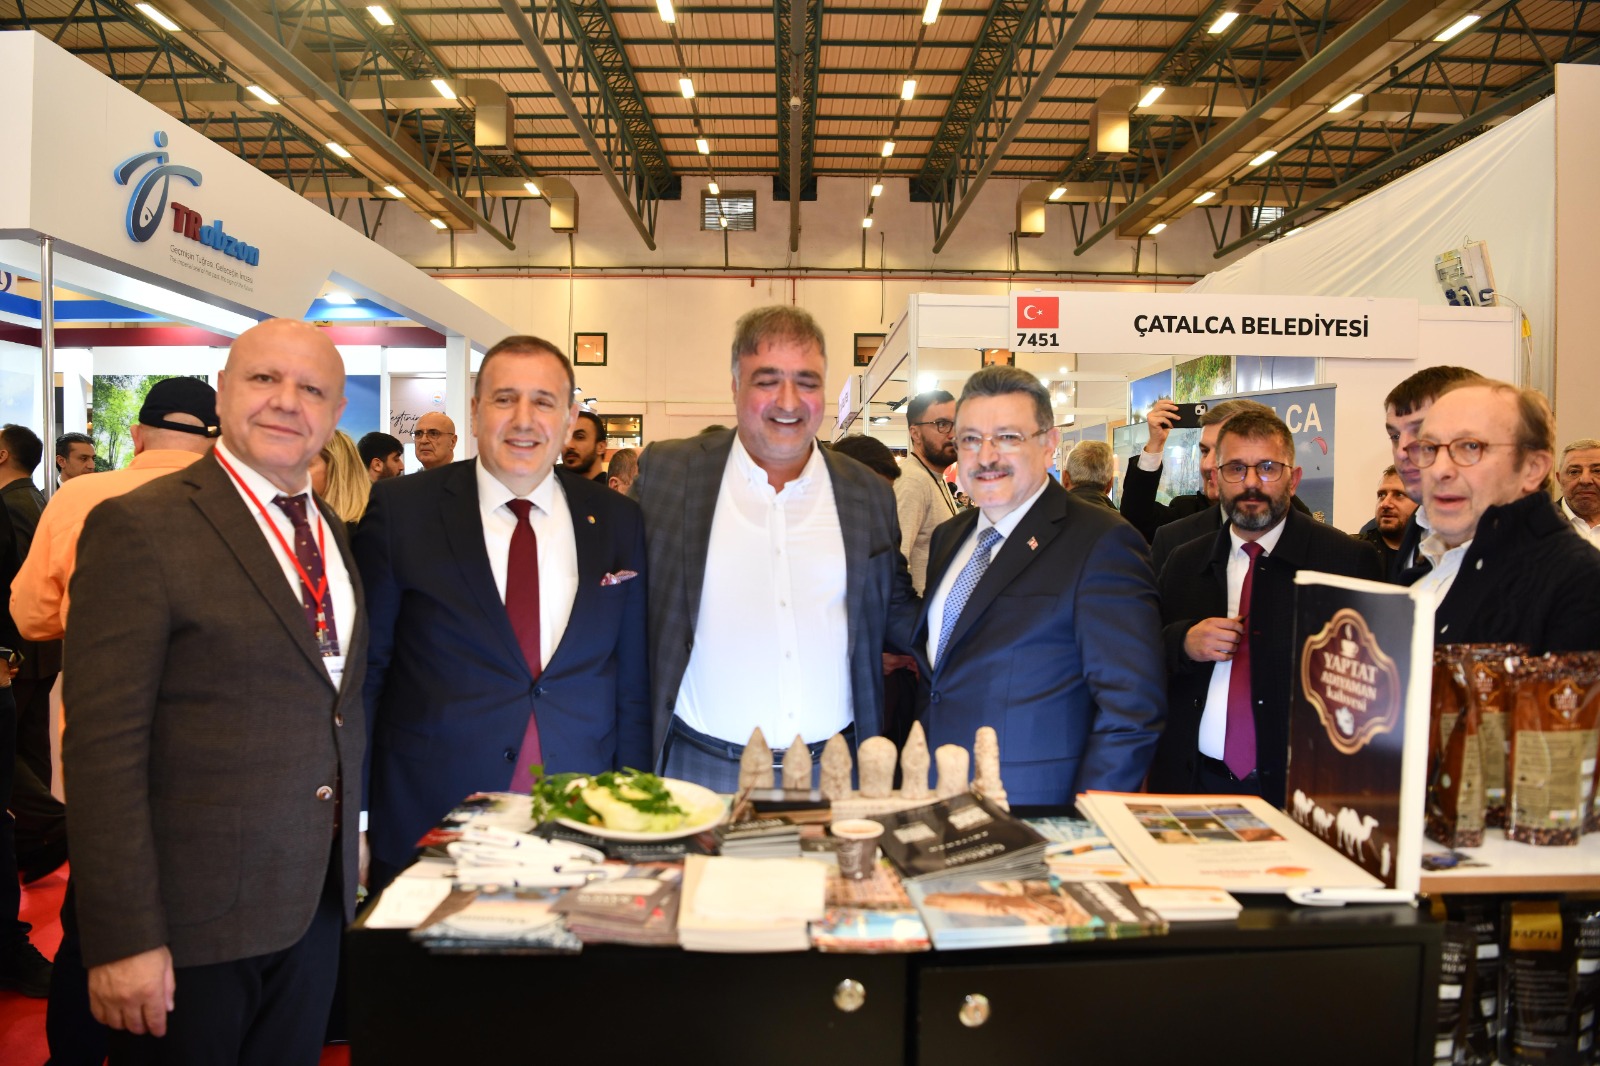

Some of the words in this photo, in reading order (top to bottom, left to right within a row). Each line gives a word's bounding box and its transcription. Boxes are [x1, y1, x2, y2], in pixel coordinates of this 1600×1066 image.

[171, 202, 260, 266] TRabzon
[1133, 314, 1236, 338] ÇATALCA
[1241, 313, 1370, 338] BELEDİYESİ
[1016, 333, 1060, 347] 7451
